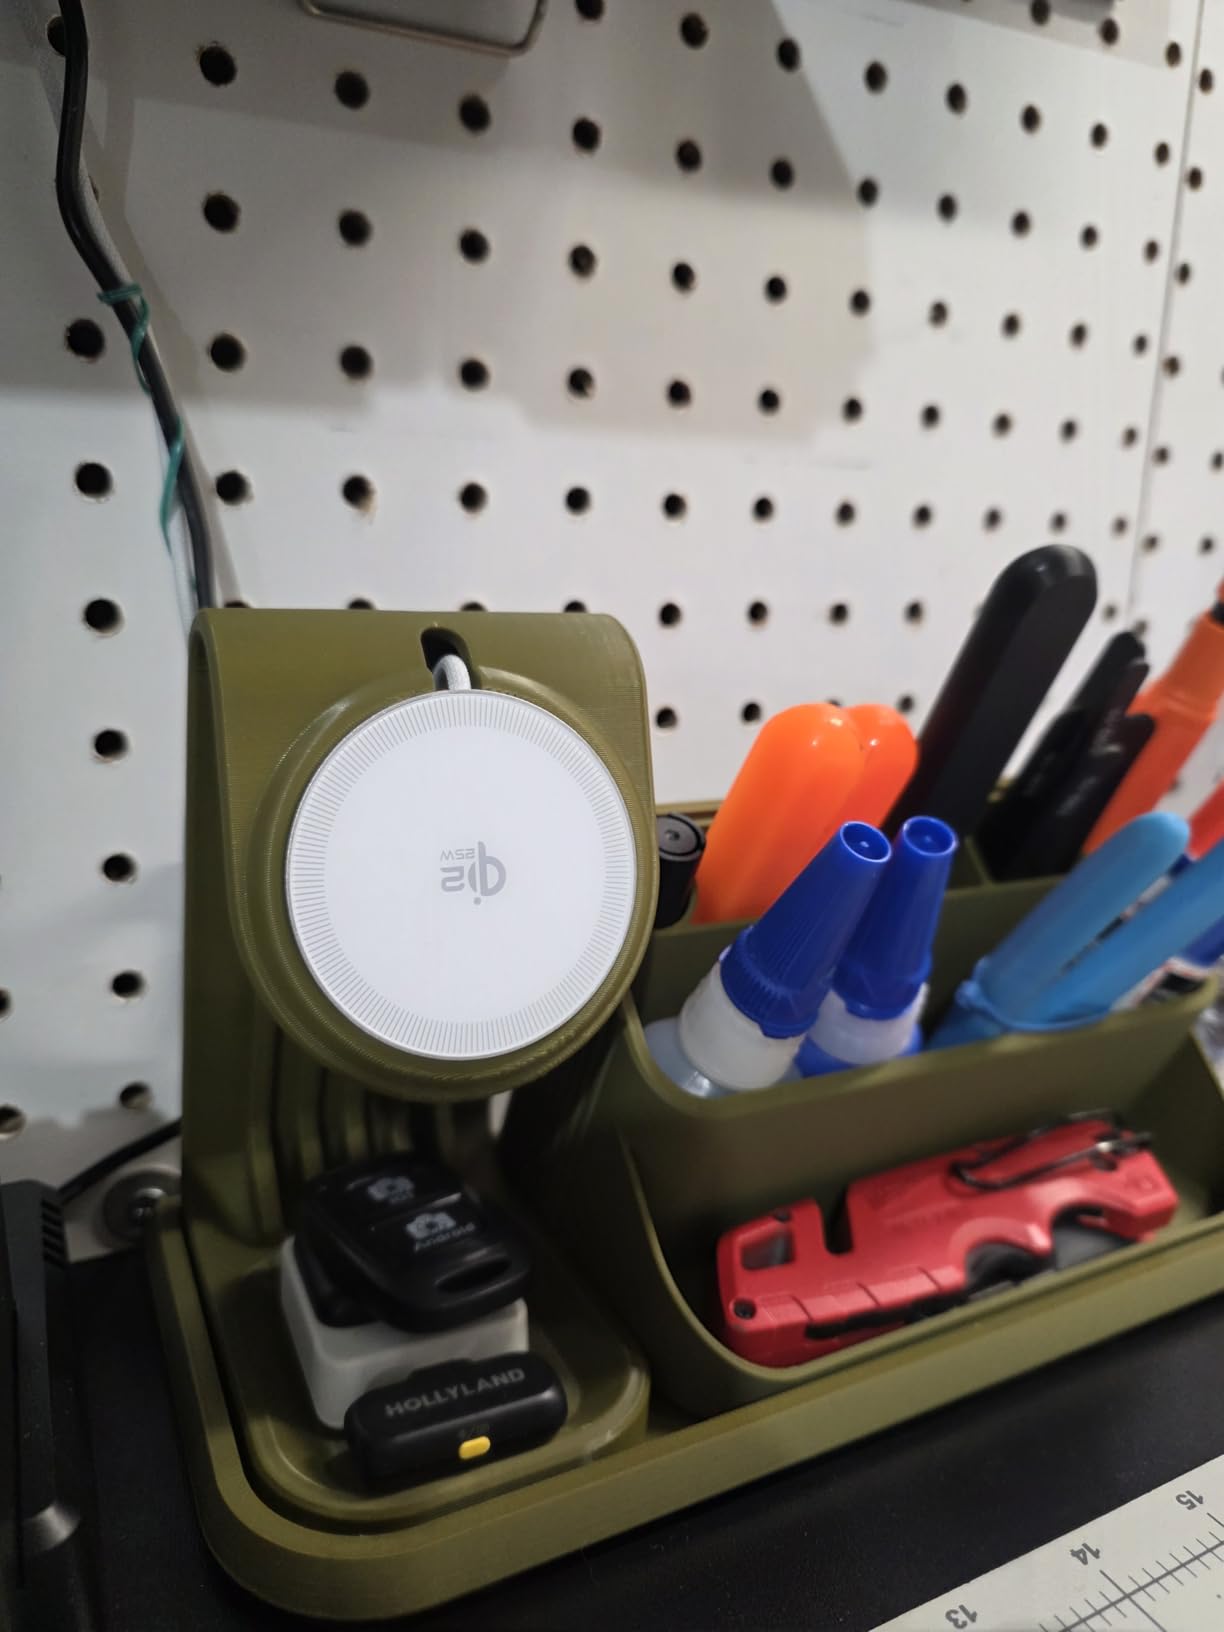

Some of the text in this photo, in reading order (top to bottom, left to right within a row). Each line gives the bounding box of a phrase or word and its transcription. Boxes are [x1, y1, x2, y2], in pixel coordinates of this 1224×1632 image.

[440, 848, 475, 860] 25W
[384, 1367, 525, 1417] HOLLYLAND
[1175, 1490, 1204, 1510] 15
[1069, 1542, 1101, 1565] 14
[945, 1604, 978, 1630] 13
